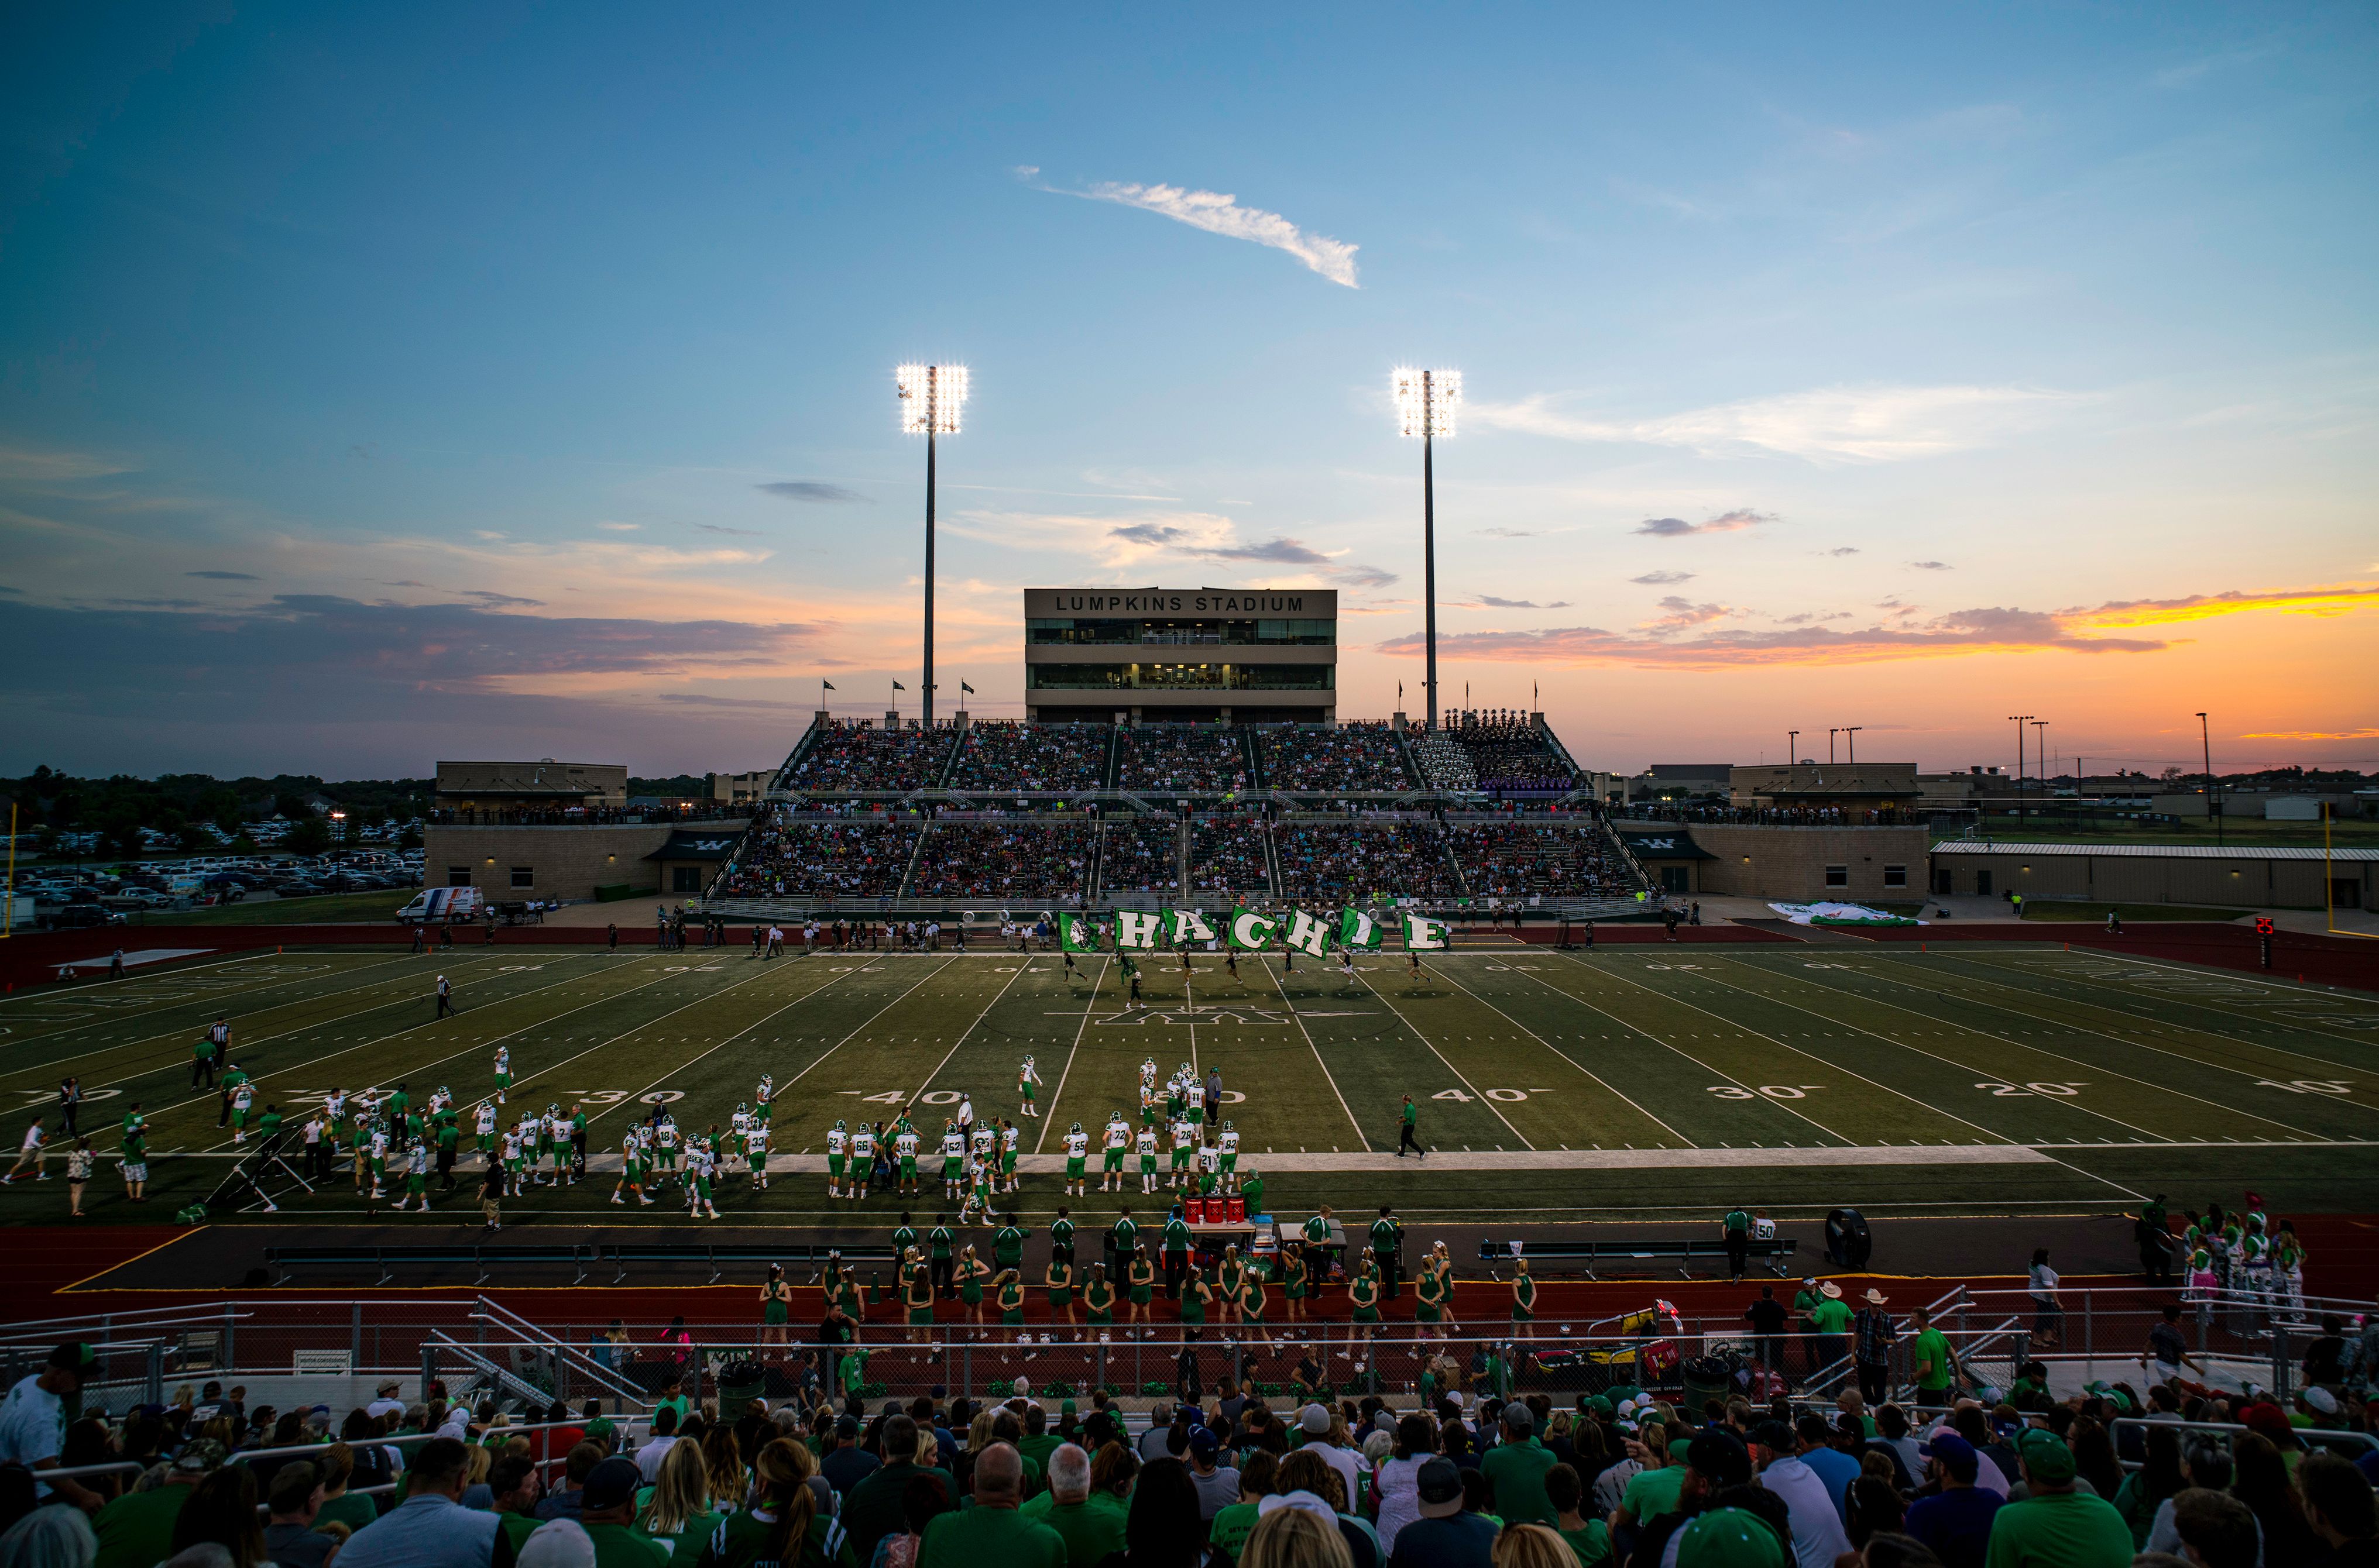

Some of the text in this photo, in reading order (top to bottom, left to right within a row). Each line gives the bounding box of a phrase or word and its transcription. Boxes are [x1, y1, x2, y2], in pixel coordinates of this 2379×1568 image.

[1056, 597, 1303, 611] LUMPKINS STADIUM
[2256, 918, 2274, 934] 25
[482, 1116, 492, 1125] 46
[524, 1126, 535, 1137] 12
[559, 1128, 565, 1137] 7
[660, 1132, 670, 1141] 18
[1115, 1130, 1125, 1140] 72
[1180, 1130, 1191, 1140] 78
[752, 1137, 764, 1147] 33
[829, 1137, 838, 1149] 62
[857, 1141, 868, 1151] 66
[901, 1141, 911, 1151] 44
[949, 1141, 960, 1151] 52
[1075, 1141, 1084, 1151] 55
[1141, 1141, 1152, 1150] 20
[1225, 1140, 1237, 1149] 82
[1201, 1154, 1211, 1166] 21
[1759, 1225, 1773, 1239] 50
